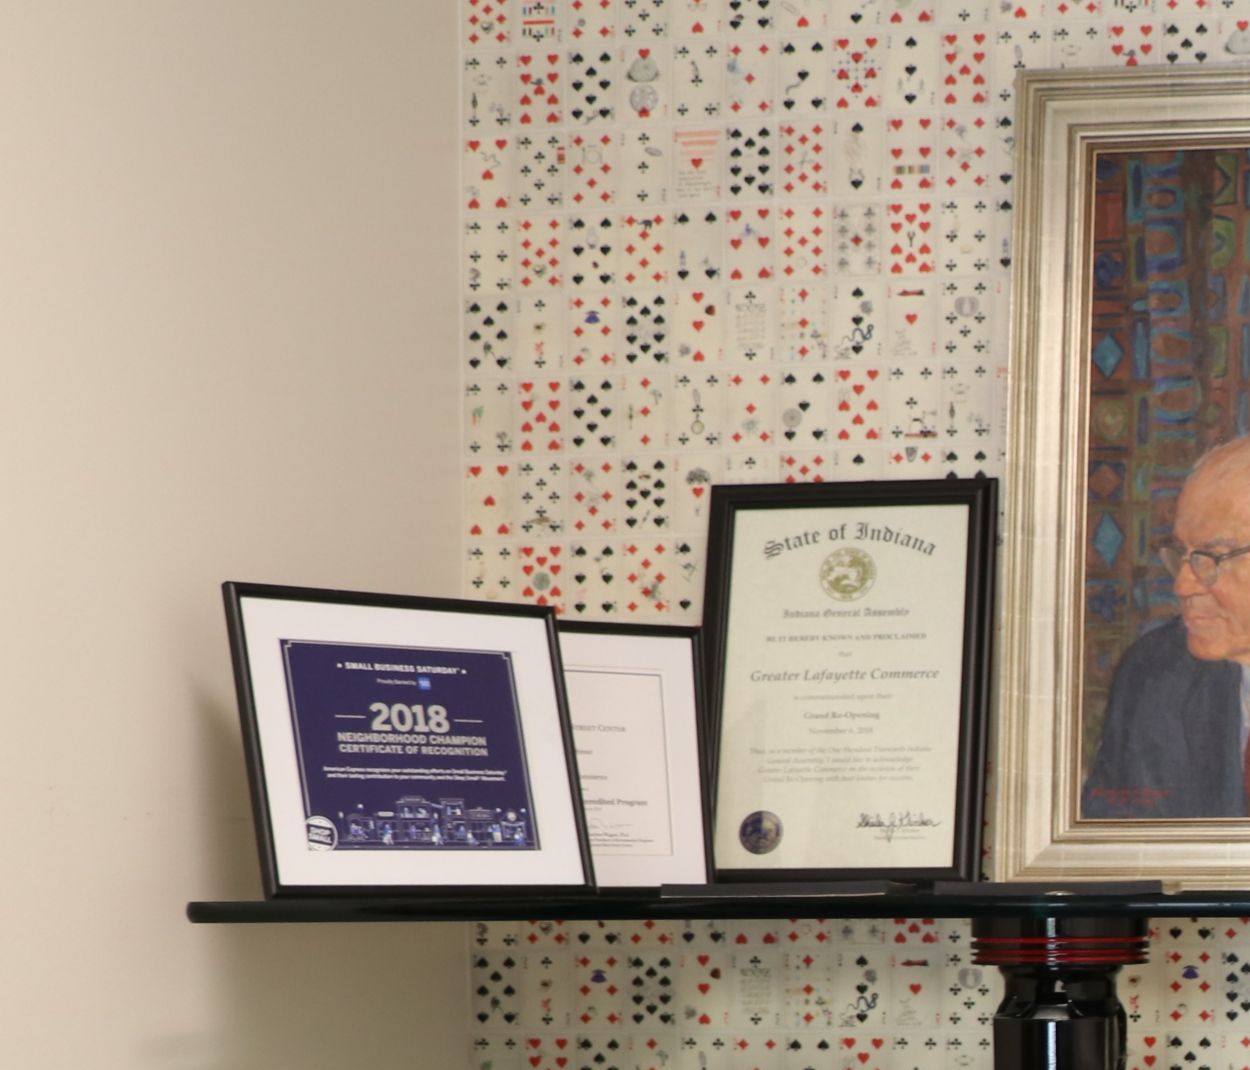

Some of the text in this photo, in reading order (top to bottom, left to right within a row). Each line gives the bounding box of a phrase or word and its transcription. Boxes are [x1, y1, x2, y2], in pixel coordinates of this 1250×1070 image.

[763, 521, 936, 560] State of Indiana
[783, 608, 910, 619] Indiana General Assembly
[344, 662, 373, 671] SMALL
[373, 663, 415, 673] BUSINESS
[750, 667, 940, 685] Greater Lafayette Commerce
[369, 702, 450, 733] 2018
[803, 711, 829, 720] Grand
[337, 732, 487, 746] NEIGHBORHOOD CHAMPION
[339, 744, 488, 757] CERTIFICATE OF RECOGNITION
